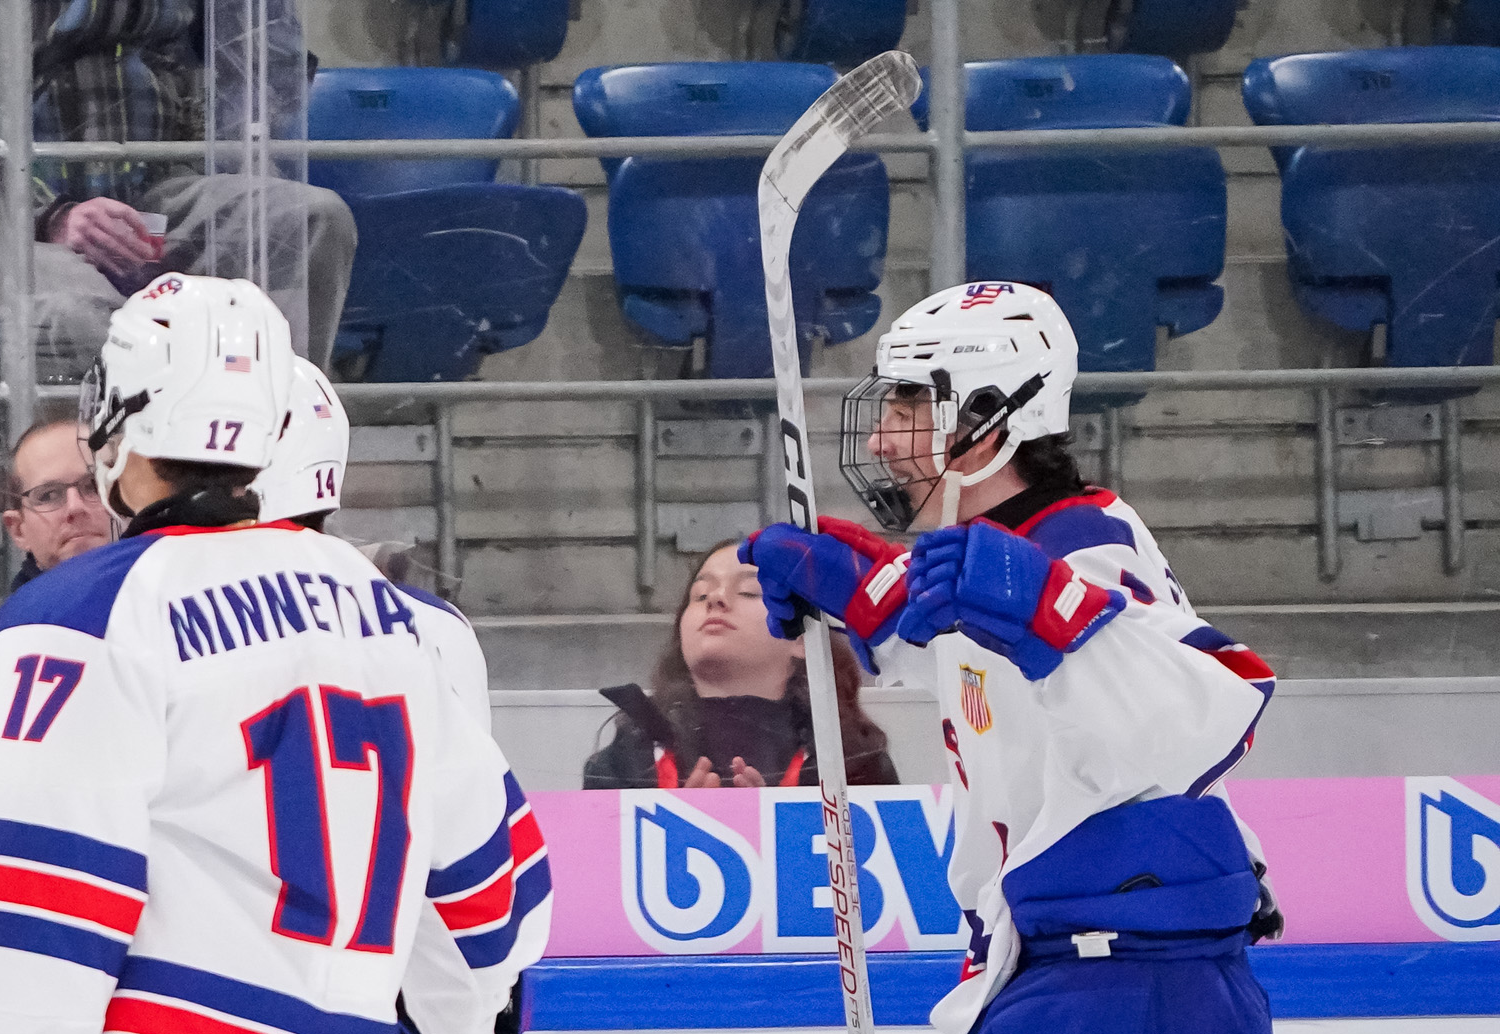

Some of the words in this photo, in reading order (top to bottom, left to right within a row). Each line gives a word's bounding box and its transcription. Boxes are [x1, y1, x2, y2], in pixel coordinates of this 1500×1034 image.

[963, 284, 1016, 304] USA
[205, 418, 244, 451] 17
[971, 405, 1009, 442] BAUER
[314, 466, 337, 499] 14
[0, 653, 86, 743] 17
[239, 683, 416, 955] 17
[820, 778, 858, 996] JETSPEED
